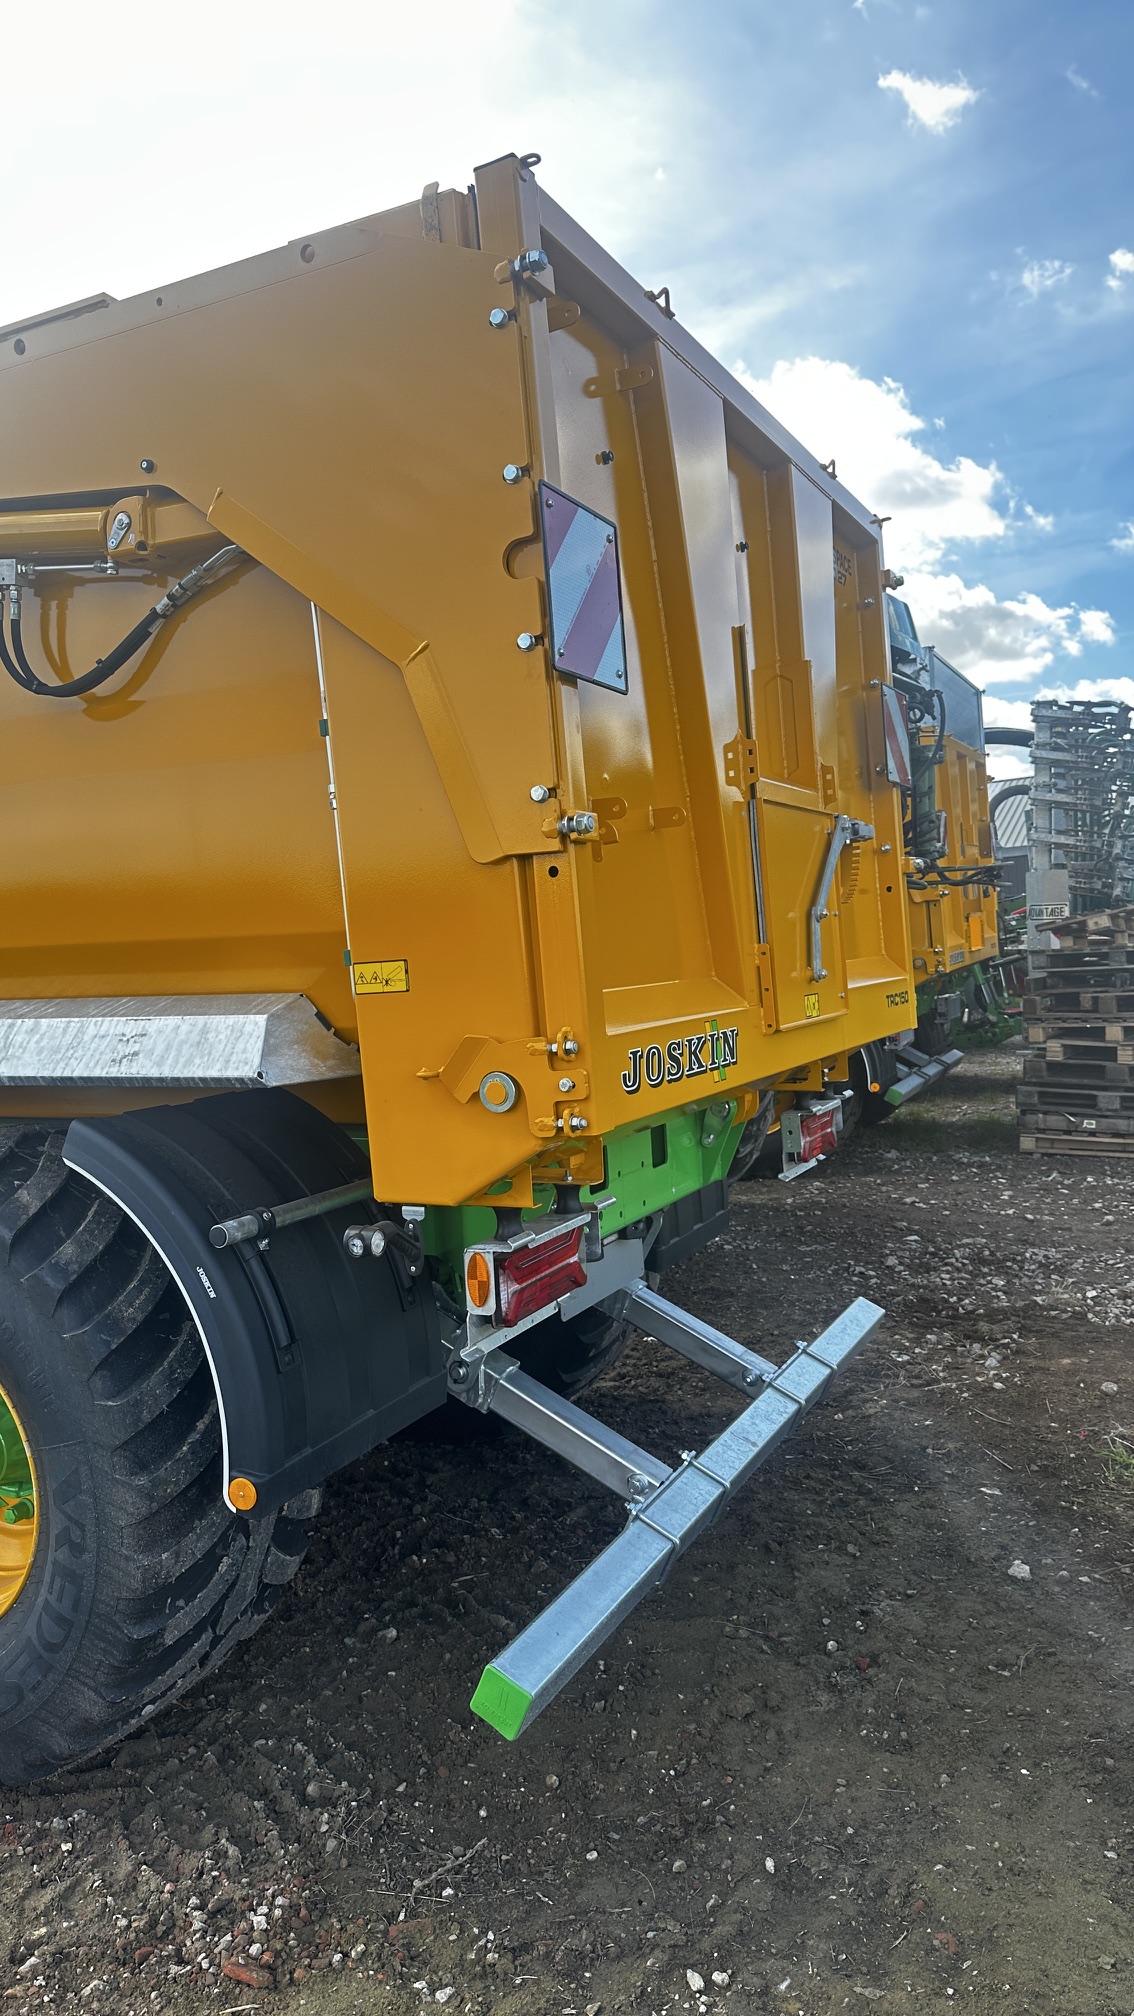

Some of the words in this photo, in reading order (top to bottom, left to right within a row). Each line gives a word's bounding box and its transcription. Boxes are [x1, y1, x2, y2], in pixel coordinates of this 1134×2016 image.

[885, 990, 909, 1009] TRC150
[620, 1026, 739, 1095] JOSKIN
[196, 1266, 217, 1299] JOSKIN
